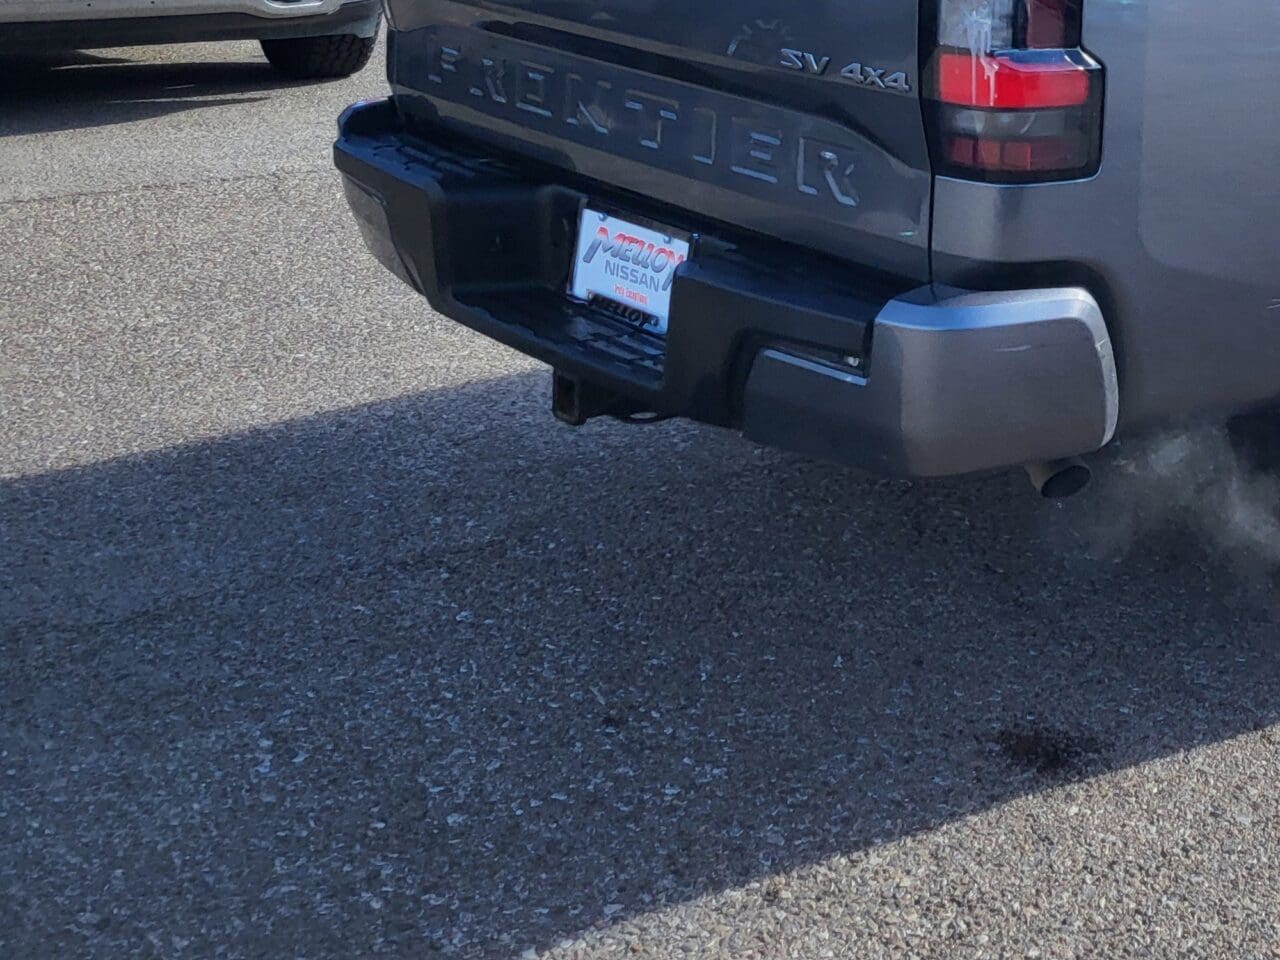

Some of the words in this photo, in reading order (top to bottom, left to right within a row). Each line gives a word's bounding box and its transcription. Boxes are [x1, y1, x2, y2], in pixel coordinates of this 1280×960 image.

[780, 48, 830, 75] SV
[582, 226, 686, 292] MELLOY
[604, 260, 660, 293] NISSAN
